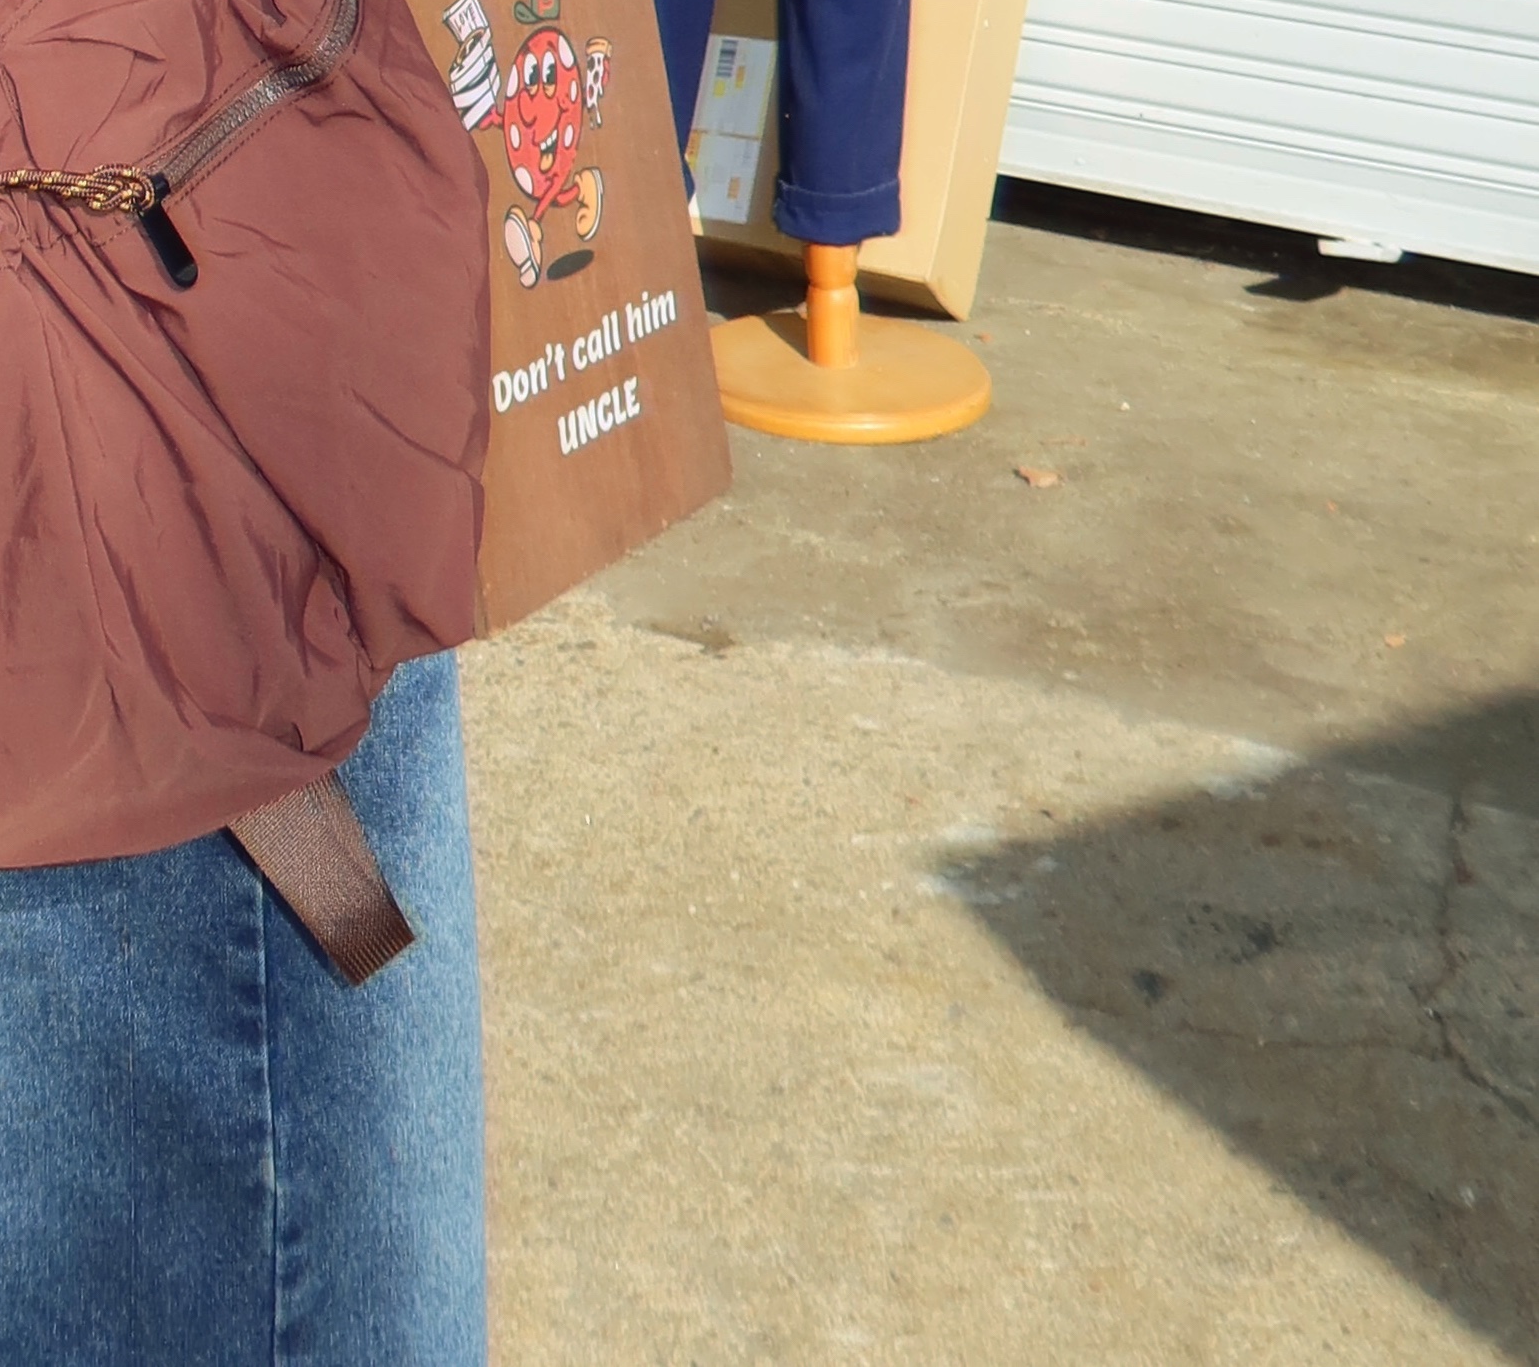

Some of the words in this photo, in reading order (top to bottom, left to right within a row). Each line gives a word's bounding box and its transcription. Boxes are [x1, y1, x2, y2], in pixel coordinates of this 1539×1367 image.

[492, 343, 566, 413] Don't
[573, 310, 621, 371] call
[625, 290, 677, 343] him
[558, 376, 641, 455] UNCLE
